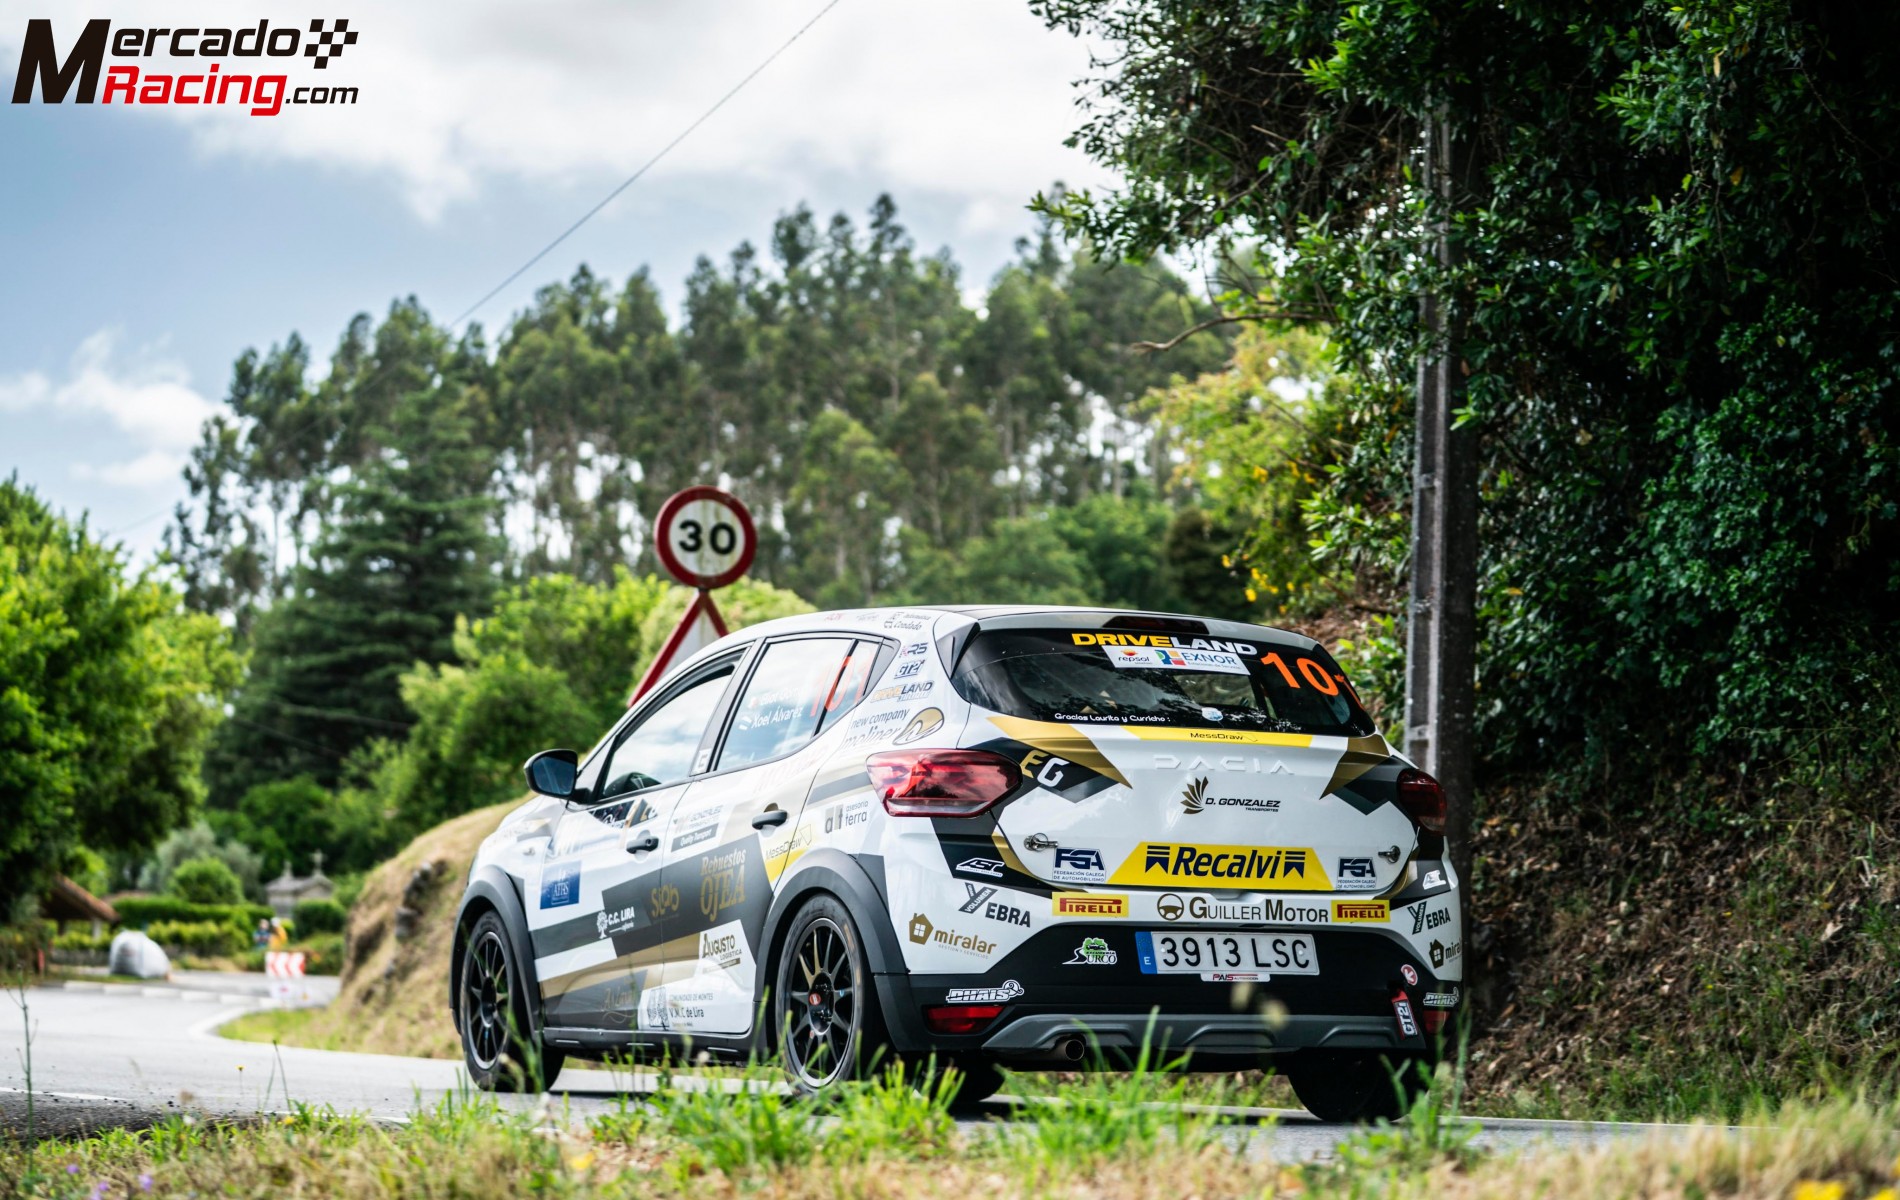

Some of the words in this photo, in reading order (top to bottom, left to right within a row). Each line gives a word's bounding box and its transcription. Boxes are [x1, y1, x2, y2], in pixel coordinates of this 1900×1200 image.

[679, 520, 736, 556] 30
[1071, 633, 1258, 655] DRIVELAND
[1184, 652, 1238, 665] EXNOR
[751, 711, 772, 729] Xoel
[770, 705, 803, 724] Álvarez
[851, 717, 869, 729] new
[869, 709, 910, 724] company
[1054, 713, 1088, 721] Gracias
[1089, 714, 1120, 722] Laurita
[1190, 732, 1243, 741] MessDraw
[1020, 750, 1069, 787] EG
[1153, 754, 1295, 774] DACIA
[1205, 797, 1216, 806] D.
[1218, 798, 1281, 808] GONZALEZ
[845, 812, 867, 827] terra
[1172, 847, 1282, 879] Recalvi
[958, 882, 1031, 928] YEBRA
[964, 888, 992, 912] VOLUMEN
[1060, 898, 1122, 914] PIRELLI
[608, 912, 620, 925] C.C.
[621, 906, 635, 922] LIRA
[1337, 904, 1385, 918] PIRELLI
[1407, 901, 1451, 935] YEBRA
[702, 933, 735, 958] AUGUSTO
[934, 929, 997, 954] miralar
[720, 949, 742, 960] LOGISTICA
[1144, 957, 1151, 965] E
[1160, 937, 1241, 967] 3913
[1251, 938, 1310, 968] LSC
[950, 989, 1009, 1001] DHAIS
[685, 1007, 693, 1017] de
[693, 1007, 705, 1017] Lira
